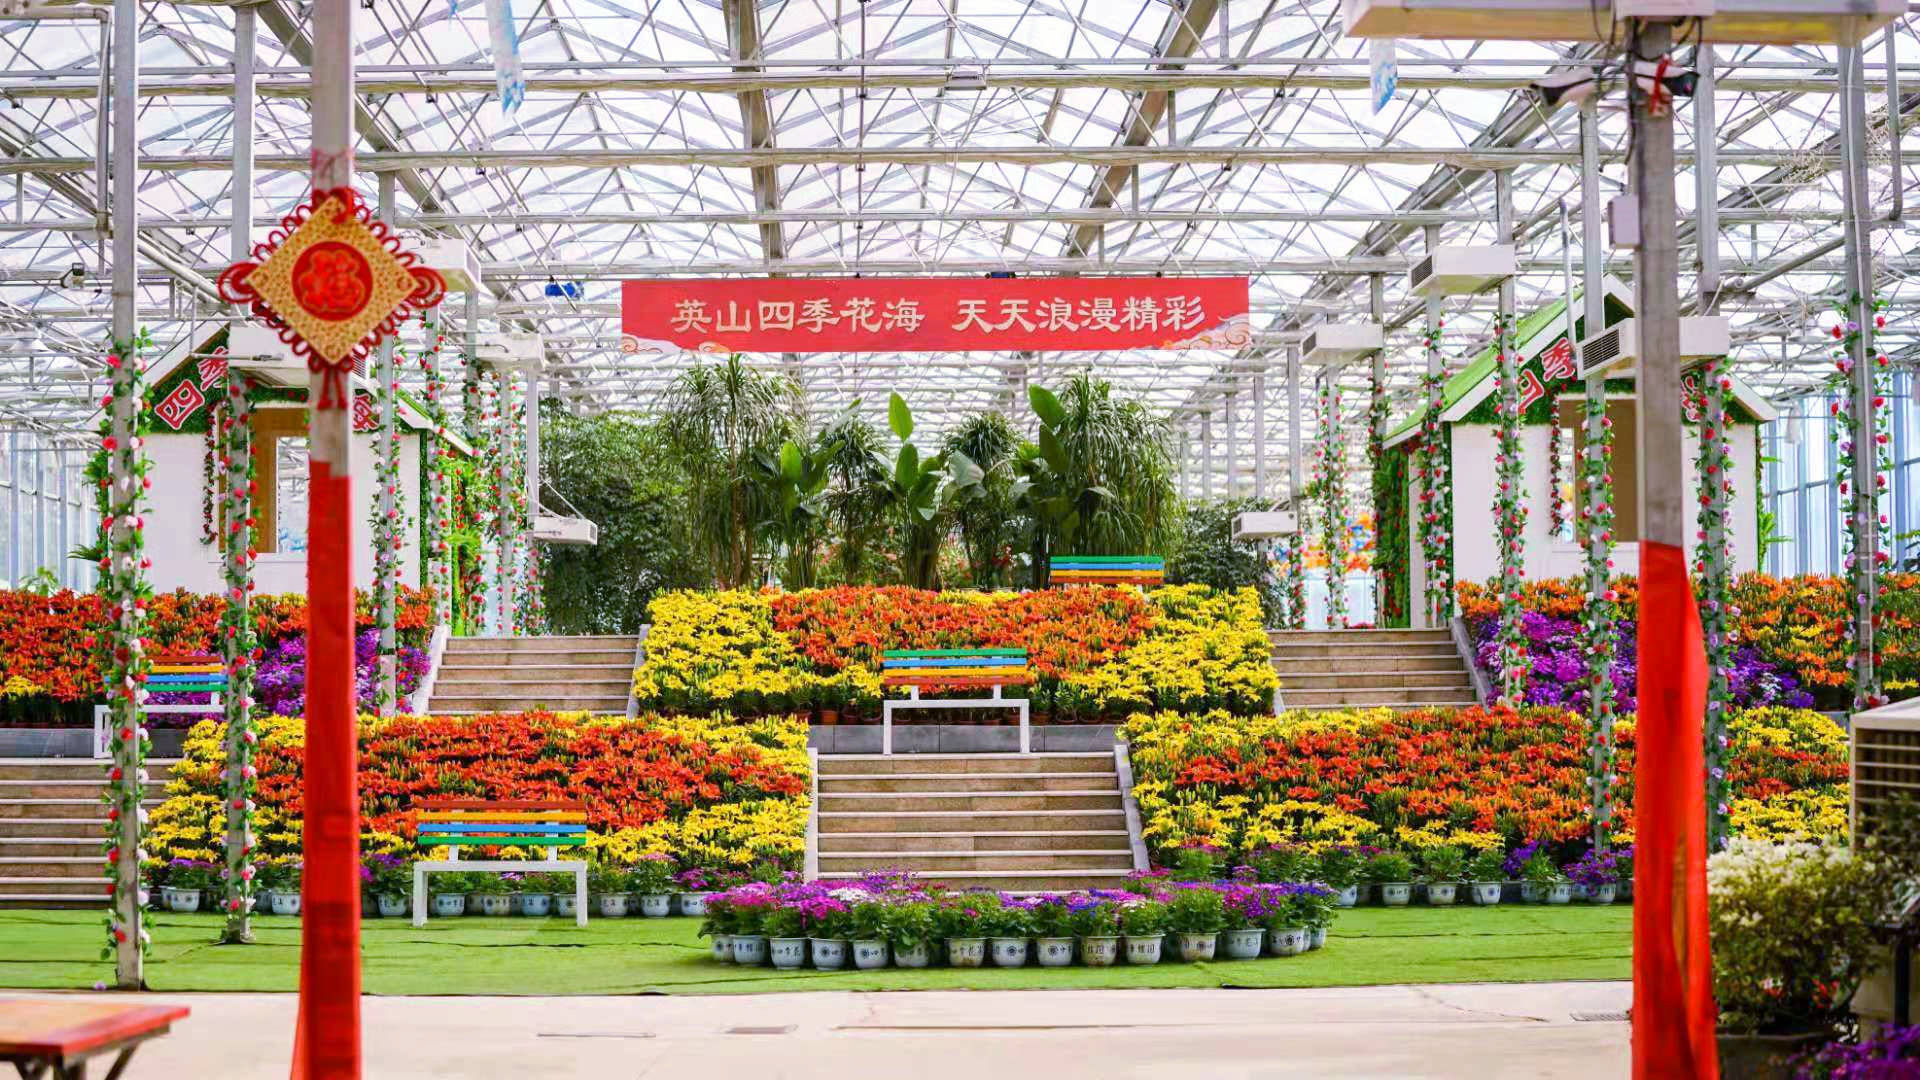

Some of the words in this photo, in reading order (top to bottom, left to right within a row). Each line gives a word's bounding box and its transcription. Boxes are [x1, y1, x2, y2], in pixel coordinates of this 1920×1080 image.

[671, 297, 926, 333] 英山四季花海
[951, 296, 1206, 333] 天天浪漫精彩
